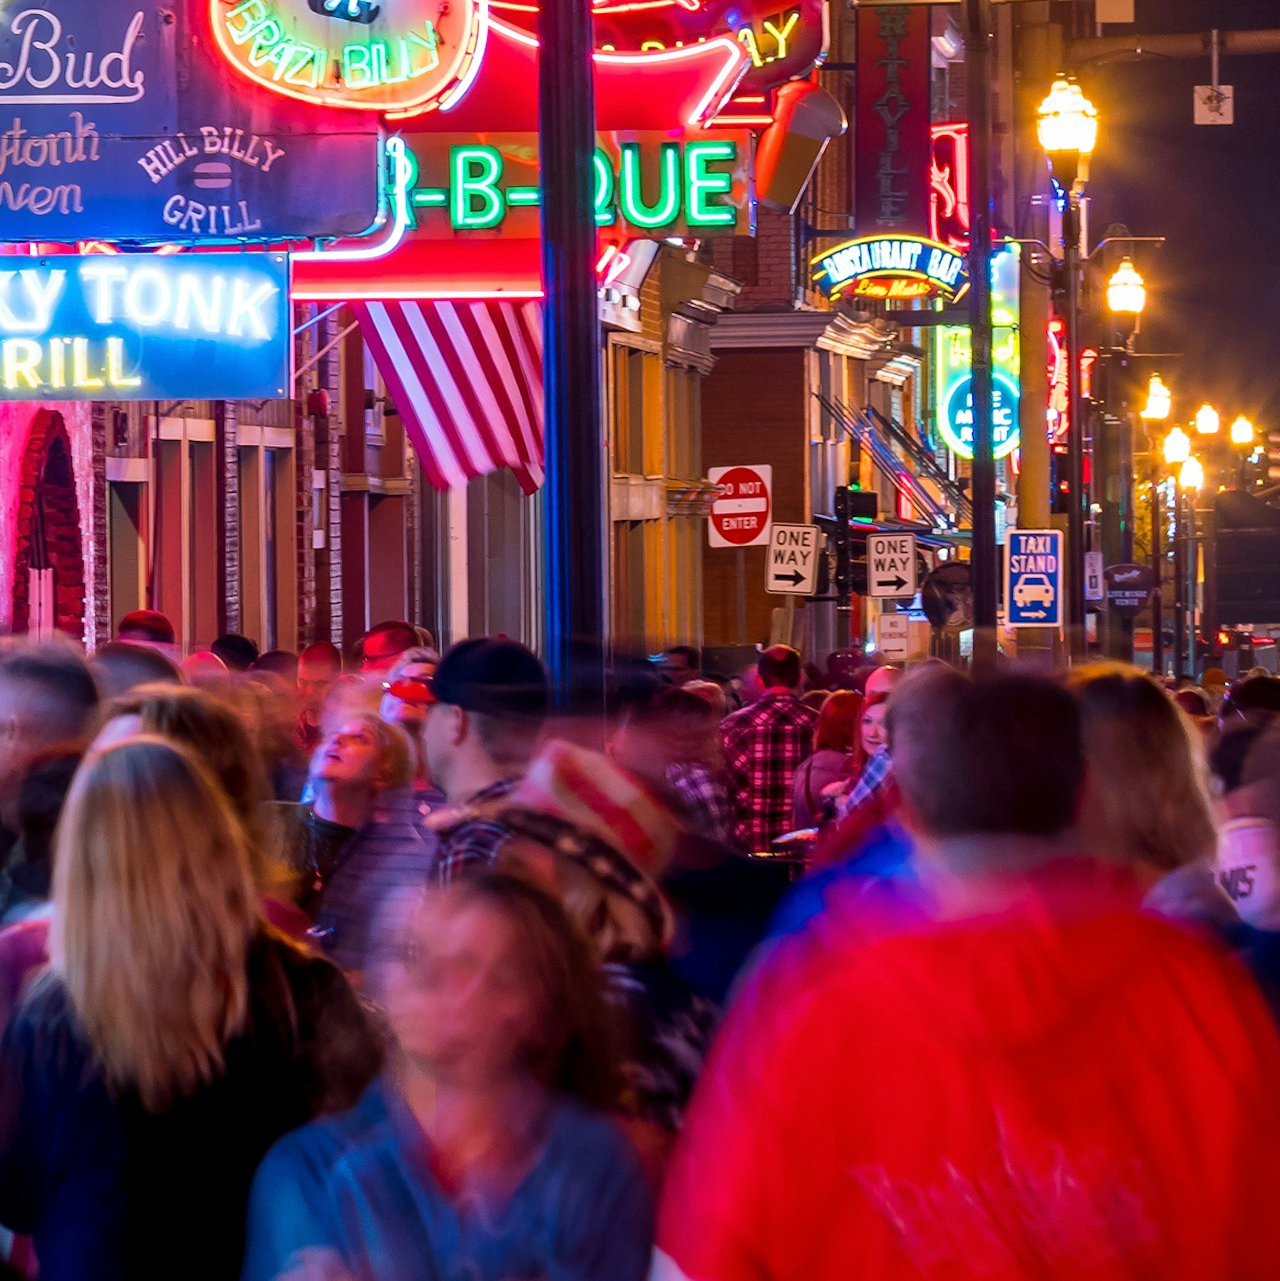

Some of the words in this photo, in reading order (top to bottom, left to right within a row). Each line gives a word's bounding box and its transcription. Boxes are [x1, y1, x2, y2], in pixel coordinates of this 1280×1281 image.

[137, 131, 198, 184] HILL
[199, 125, 286, 172] BILLY
[162, 194, 262, 235] GRILL
[928, 248, 963, 284] BAR
[80, 264, 280, 341] TONK
[738, 481, 762, 494] NOT
[721, 516, 758, 531] ENTER
[775, 530, 811, 547] ONE
[874, 539, 910, 555] ONE
[1019, 536, 1052, 554] TAXI
[773, 549, 811, 566] WAY
[873, 557, 911, 573] WAY
[1010, 555, 1057, 573] STAND
